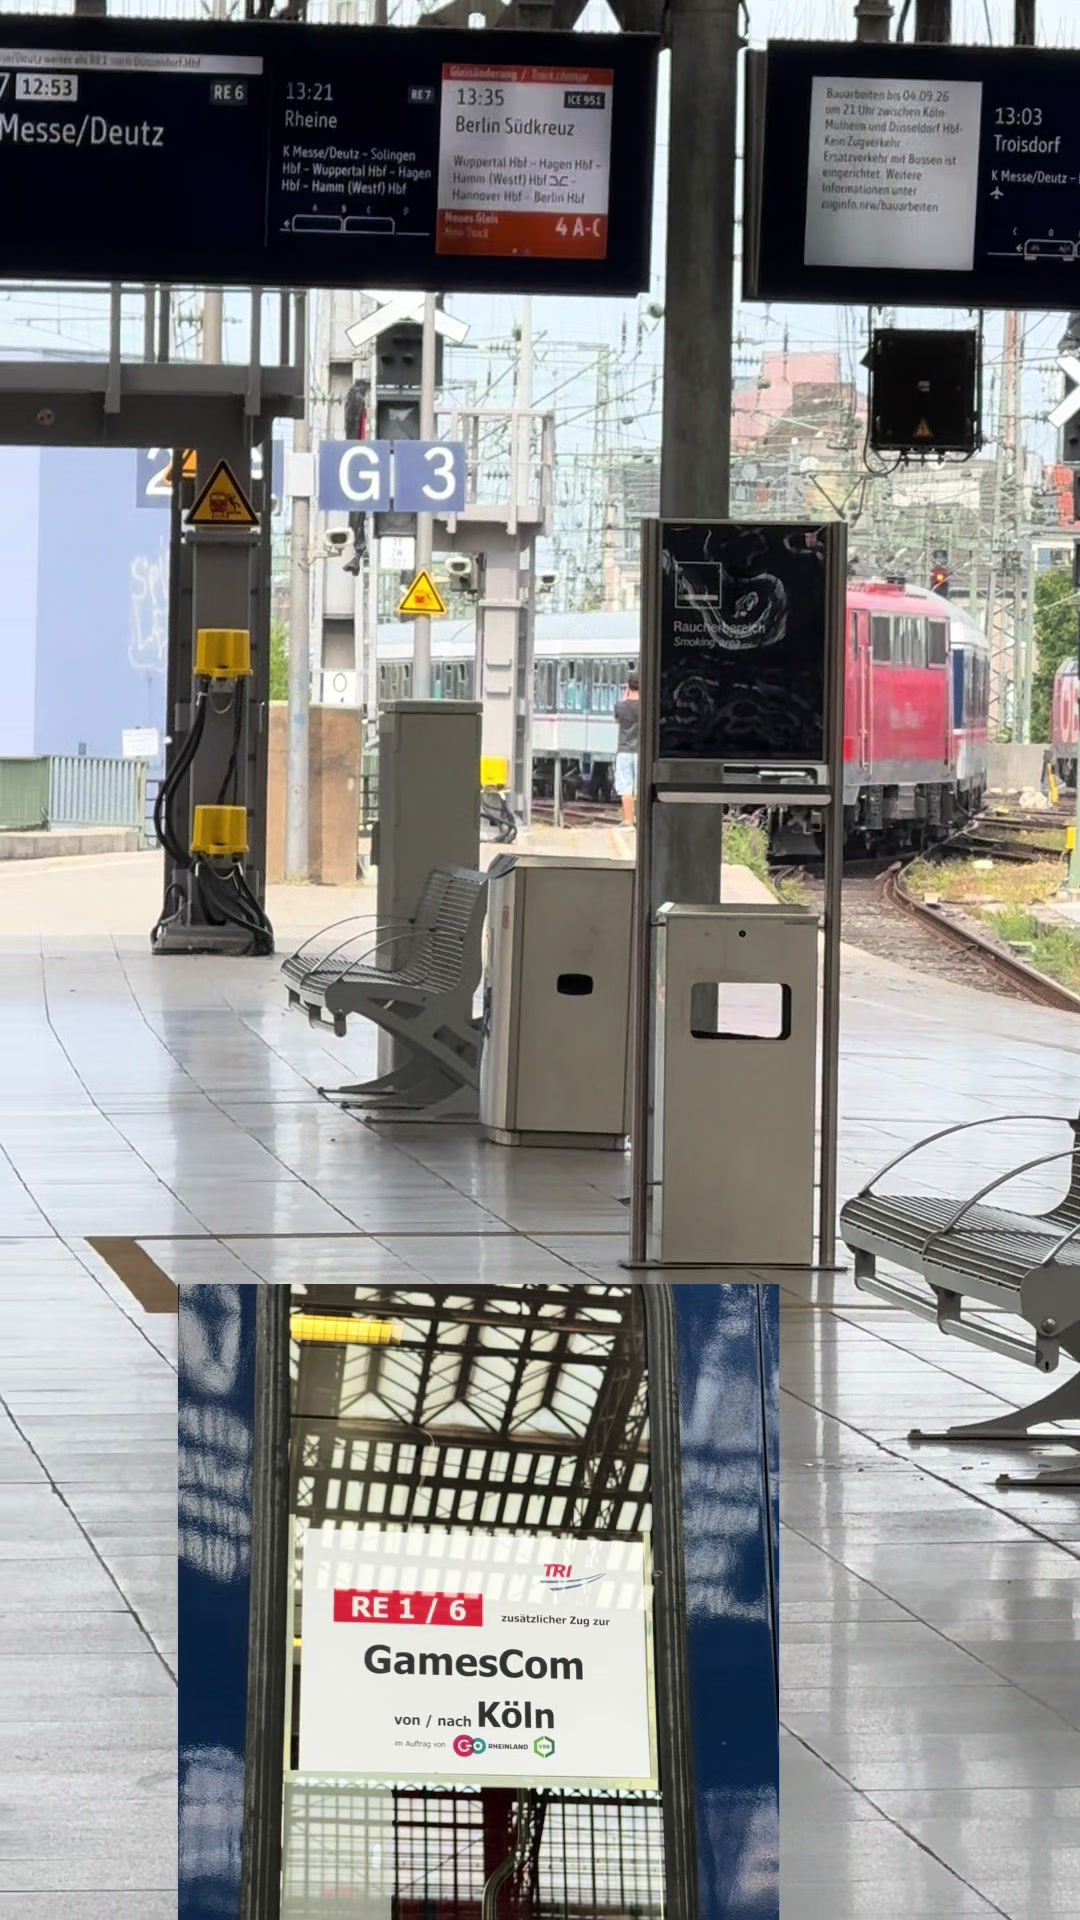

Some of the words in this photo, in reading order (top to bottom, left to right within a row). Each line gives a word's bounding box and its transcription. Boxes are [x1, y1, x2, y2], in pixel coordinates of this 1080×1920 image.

[22, 78, 72, 96] 12:53
[214, 84, 232, 100] RE
[235, 85, 244, 100] 6
[286, 82, 334, 100] 13:21
[411, 88, 424, 100] RE
[424, 89, 432, 100] 7
[826, 88, 884, 100] Bauarbeiten
[457, 88, 505, 106] 13:35
[568, 94, 582, 105] ICE
[583, 95, 602, 105] 951
[825, 106, 840, 115] um
[843, 103, 855, 115] 21
[858, 104, 875, 115] Uhr
[878, 106, 920, 117] zwischen
[995, 107, 1042, 126] 13:03
[284, 109, 338, 128] Rheine
[456, 116, 500, 133] Berlin
[505, 117, 575, 136] Südkreuz
[0, 112, 164, 147] Messe/Deutz
[868, 122, 886, 132] und
[824, 136, 845, 147] Kein
[848, 138, 901, 150] Zugverkehr
[993, 134, 1061, 154] Troisdorf
[282, 145, 290, 157] K
[292, 146, 359, 160] Messe/Deutz
[370, 148, 416, 163] Solingen
[824, 152, 888, 165] Ersatzverkehr
[890, 154, 906, 164] mit
[908, 154, 942, 165] Bussen
[944, 155, 957, 166] ist
[282, 162, 301, 174] Hbf
[312, 163, 365, 178] Wuppertal
[368, 165, 387, 177] Hbf
[398, 166, 432, 180] Hagen
[454, 155, 506, 169] Wuppertal
[509, 157, 528, 168] Hbf
[539, 159, 572, 172] Hagen
[574, 160, 593, 170] Hbf
[452, 174, 485, 184] Hamm
[488, 173, 526, 186] (Westf)
[528, 175, 548, 185] Hbf
[886, 169, 922, 181] Weitere
[991, 170, 998, 181] K
[1001, 170, 1068, 184] Messe/Deutz
[282, 179, 300, 192] Hbf
[312, 180, 344, 193] Hamm
[348, 182, 385, 196] (Westf)
[388, 183, 407, 195] Hbf
[822, 184, 890, 196] Informationen
[892, 186, 917, 196] unter
[452, 189, 500, 200] Hannover
[504, 190, 522, 201] Hbf
[534, 191, 564, 203] Berlin
[567, 193, 585, 204] Hbf
[556, 216, 568, 236] 4
[572, 217, 601, 237] A-C
[339, 446, 379, 500] G
[422, 446, 456, 500] 3
[673, 620, 766, 634] Raucherbereich
[673, 637, 715, 648] Smoking
[719, 640, 740, 648] area
[543, 1564, 572, 1578] TRI
[351, 1596, 388, 1618] RE
[399, 1598, 414, 1619] 1
[425, 1598, 437, 1624] /
[449, 1600, 466, 1621] 6
[501, 1614, 567, 1625] zusätzlicher
[569, 1615, 590, 1628] Zug
[593, 1618, 610, 1626] zur
[364, 1644, 584, 1680] GamesCom
[394, 1716, 420, 1726] von
[426, 1714, 432, 1728] /
[438, 1716, 471, 1727] nach
[478, 1701, 554, 1729] Köln
[394, 1739, 403, 1747] im
[405, 1739, 431, 1748] Auftrag
